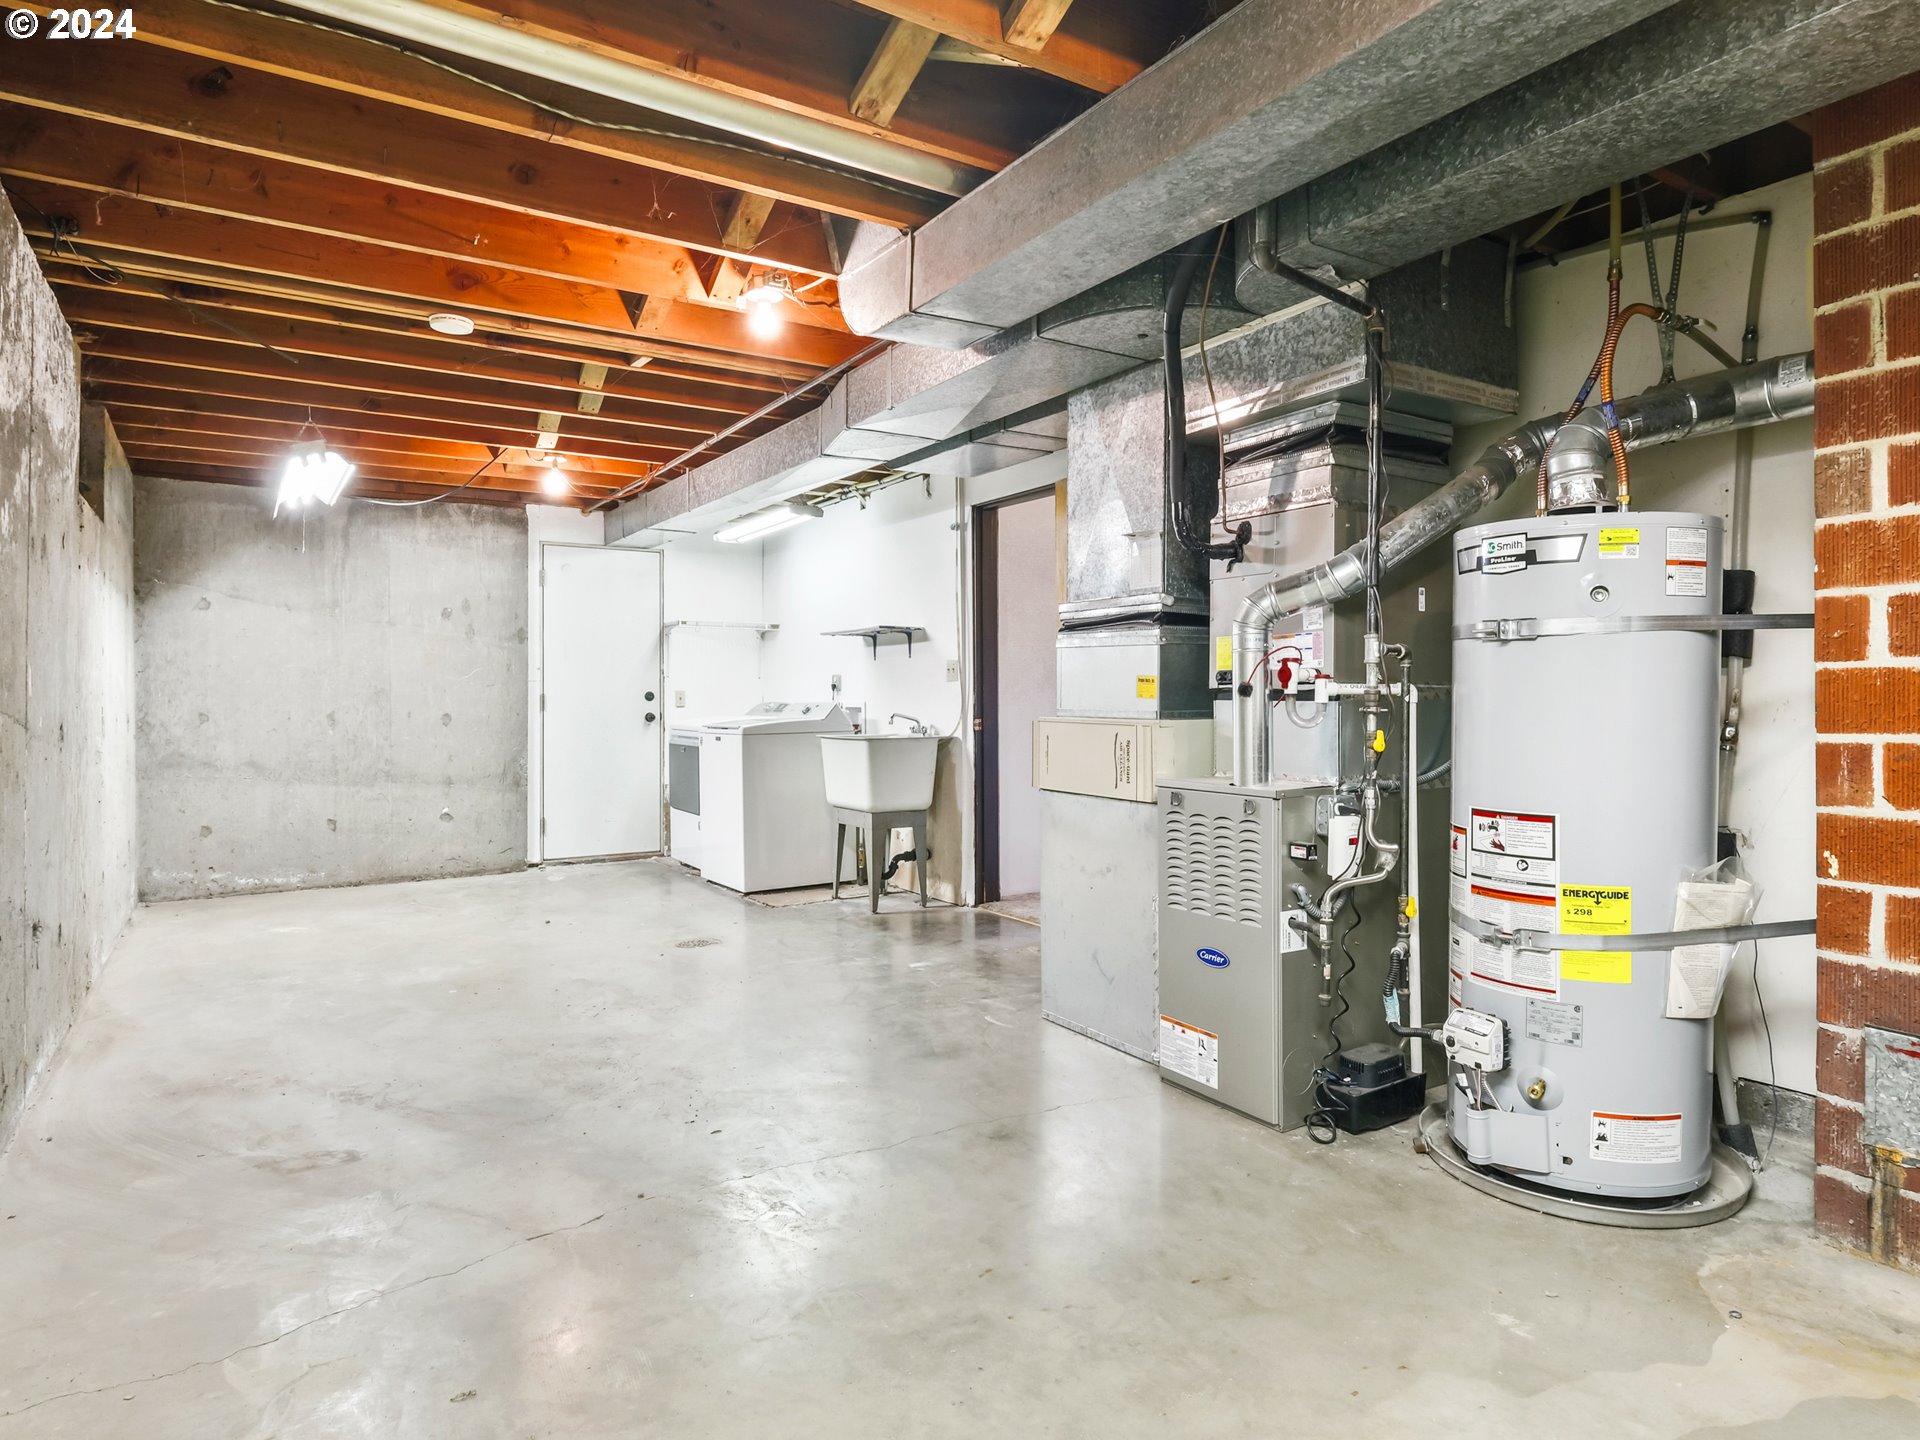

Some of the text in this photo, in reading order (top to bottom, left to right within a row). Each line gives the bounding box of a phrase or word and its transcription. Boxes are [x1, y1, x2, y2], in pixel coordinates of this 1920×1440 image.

[1497, 541, 1523, 551] Smith
[1573, 908, 1593, 916] 298
[1199, 951, 1225, 964] Carrier
